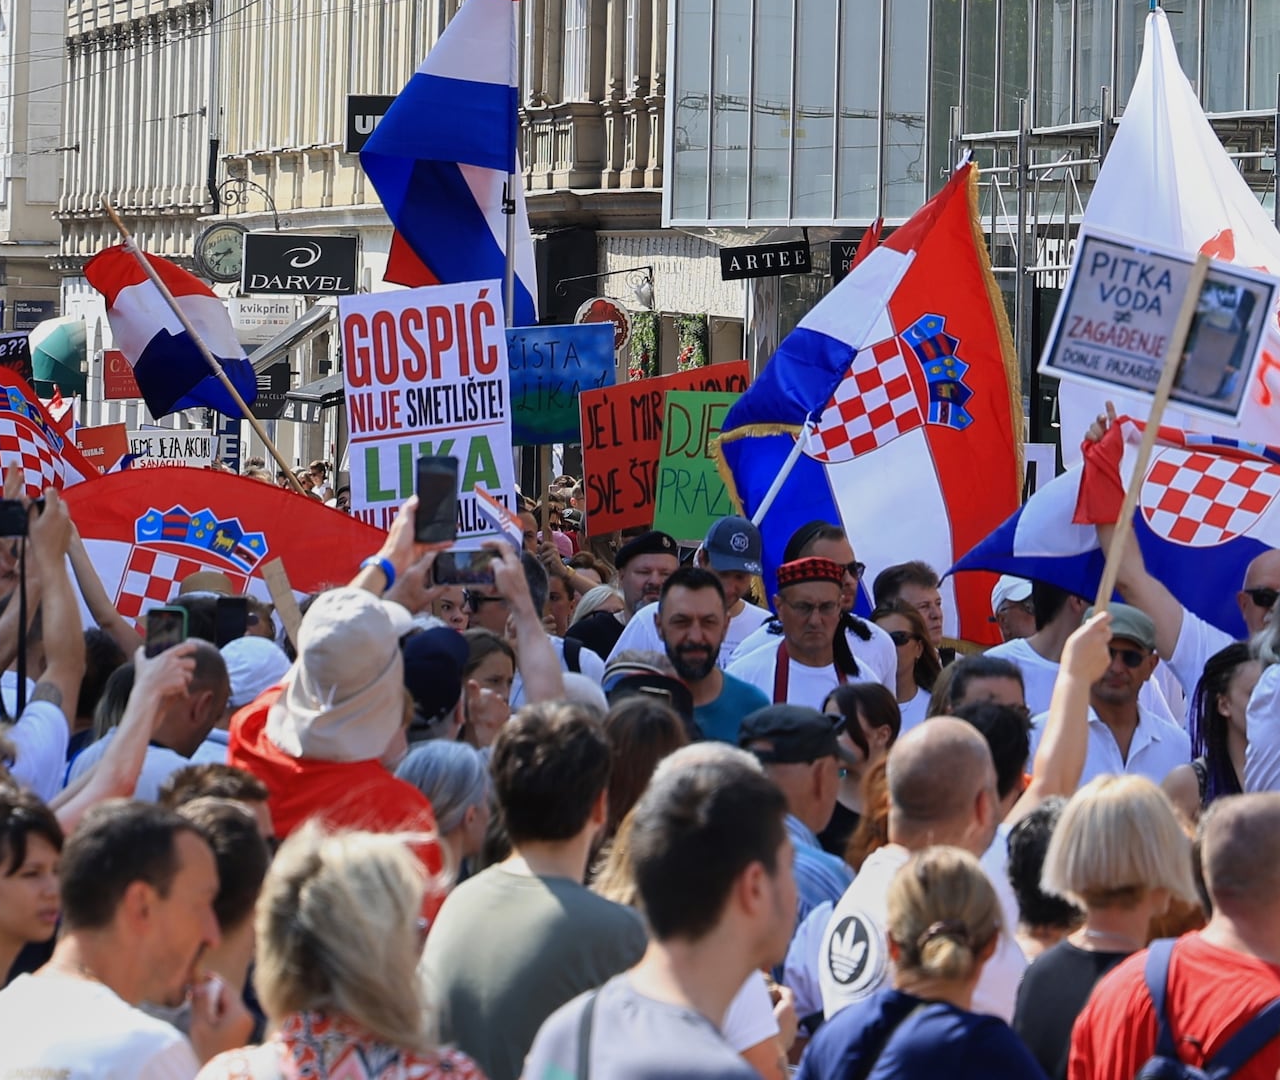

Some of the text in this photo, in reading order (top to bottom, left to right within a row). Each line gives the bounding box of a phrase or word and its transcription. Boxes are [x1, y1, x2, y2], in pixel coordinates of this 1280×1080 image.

[354, 115, 384, 134] U
[729, 249, 806, 271] ARTEE
[841, 246, 857, 257] VA
[250, 274, 350, 292] DARVEL
[1090, 251, 1173, 295] PITKA
[240, 303, 290, 315] kvikprint
[1099, 283, 1163, 317] VODA
[344, 288, 499, 389] GOSPIĆ
[1062, 349, 1163, 383] DONJE PAZARIŠT
[350, 376, 505, 434] NIJE SMETLIŠTE!
[630, 390, 663, 442] MIR
[169, 437, 183, 458] ZA
[665, 402, 730, 460] DJE
[588, 468, 624, 517] SVE
